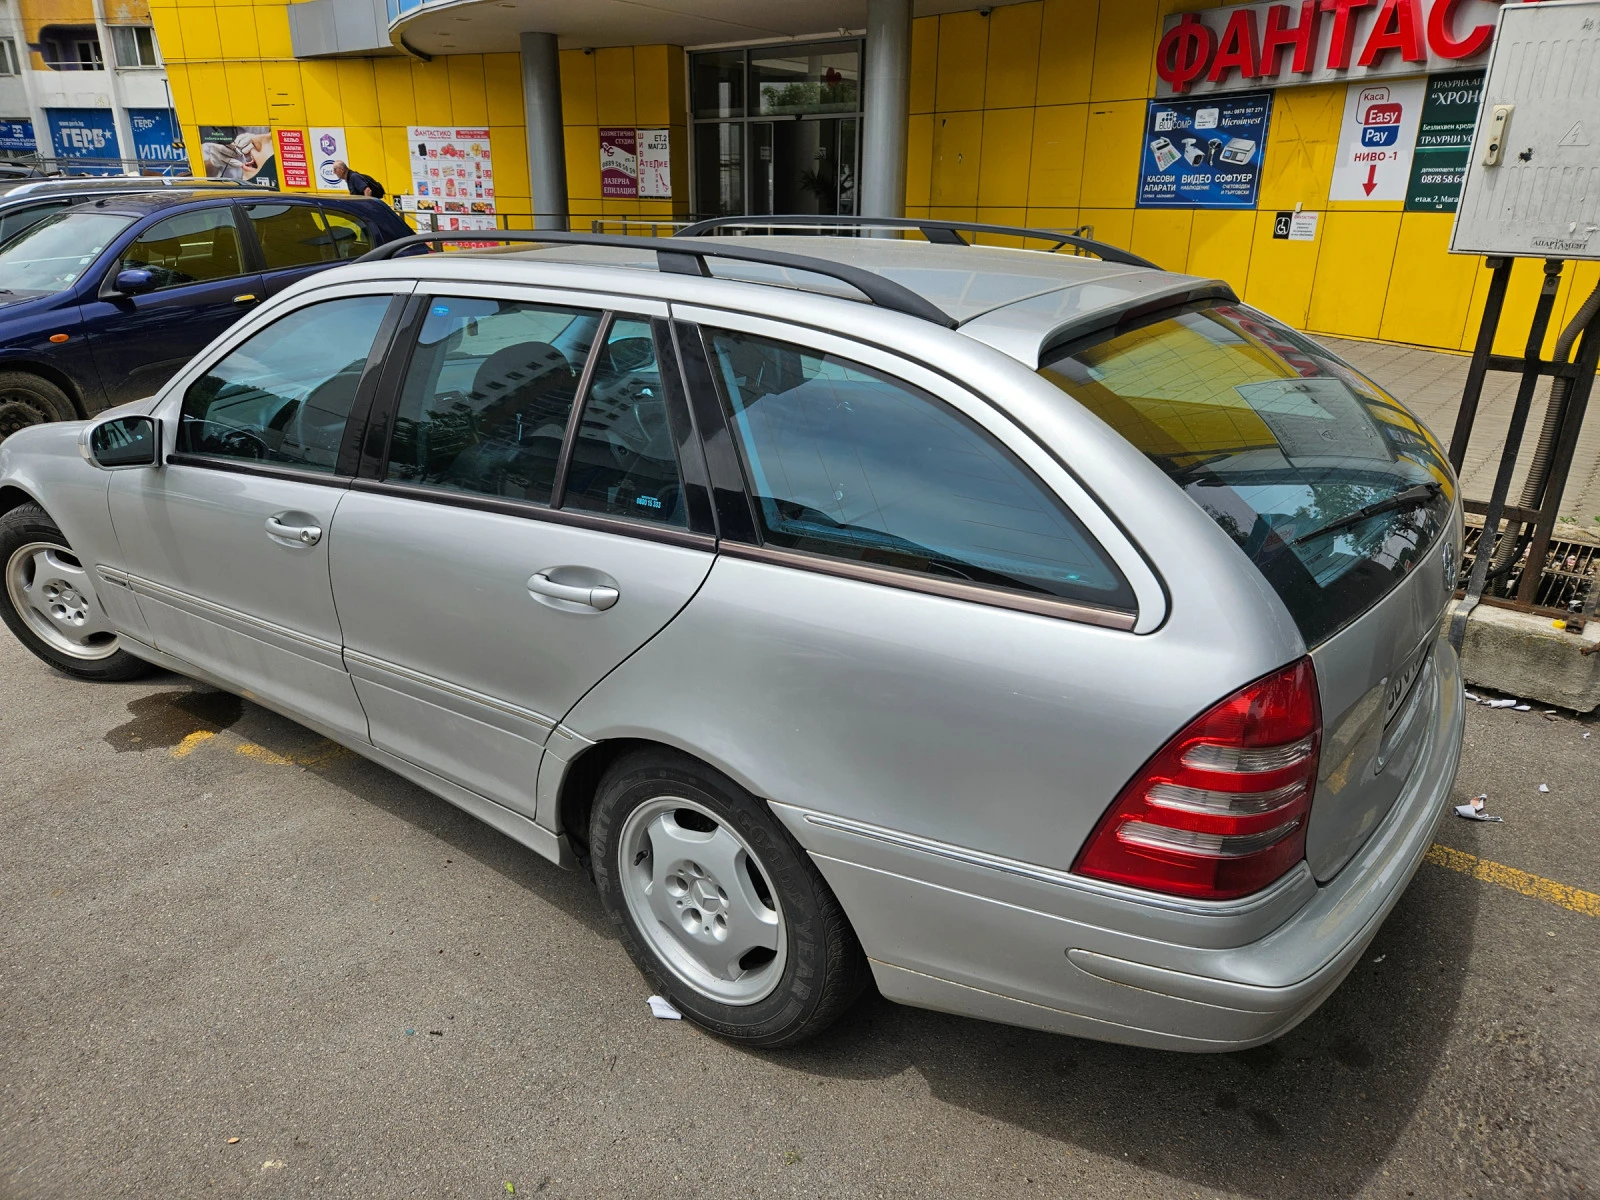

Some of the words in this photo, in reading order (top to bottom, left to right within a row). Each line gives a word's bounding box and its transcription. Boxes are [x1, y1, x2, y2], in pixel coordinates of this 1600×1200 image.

[1156, 0, 1496, 93] ФАНТАС
[1433, 79, 1470, 89] ТРАУРНА
[1363, 93, 1385, 101] Каса
[1220, 116, 1261, 126] Microinvest
[1368, 109, 1399, 124] Easy
[134, 119, 153, 128] ГЕРБ
[1422, 123, 1454, 131] Безлихвен
[414, 128, 452, 137] ФАНТАСТИКО
[1365, 129, 1388, 143] Pay
[61, 128, 106, 148] ГЕРБ
[1420, 136, 1461, 145] ТРАУРНИ
[138, 144, 187, 160] ИЛИН
[1354, 152, 1386, 162] НИВО
[1388, 151, 1398, 161] -1
[1147, 175, 1176, 183] КАСОВИ
[1181, 174, 1212, 184] ВИДЕО
[1214, 174, 1252, 183] СОФТУЕР
[1421, 175, 1442, 184] 0878
[1442, 175, 1454, 184] 58
[604, 186, 636, 195] ЕПИЛАЦИЯ
